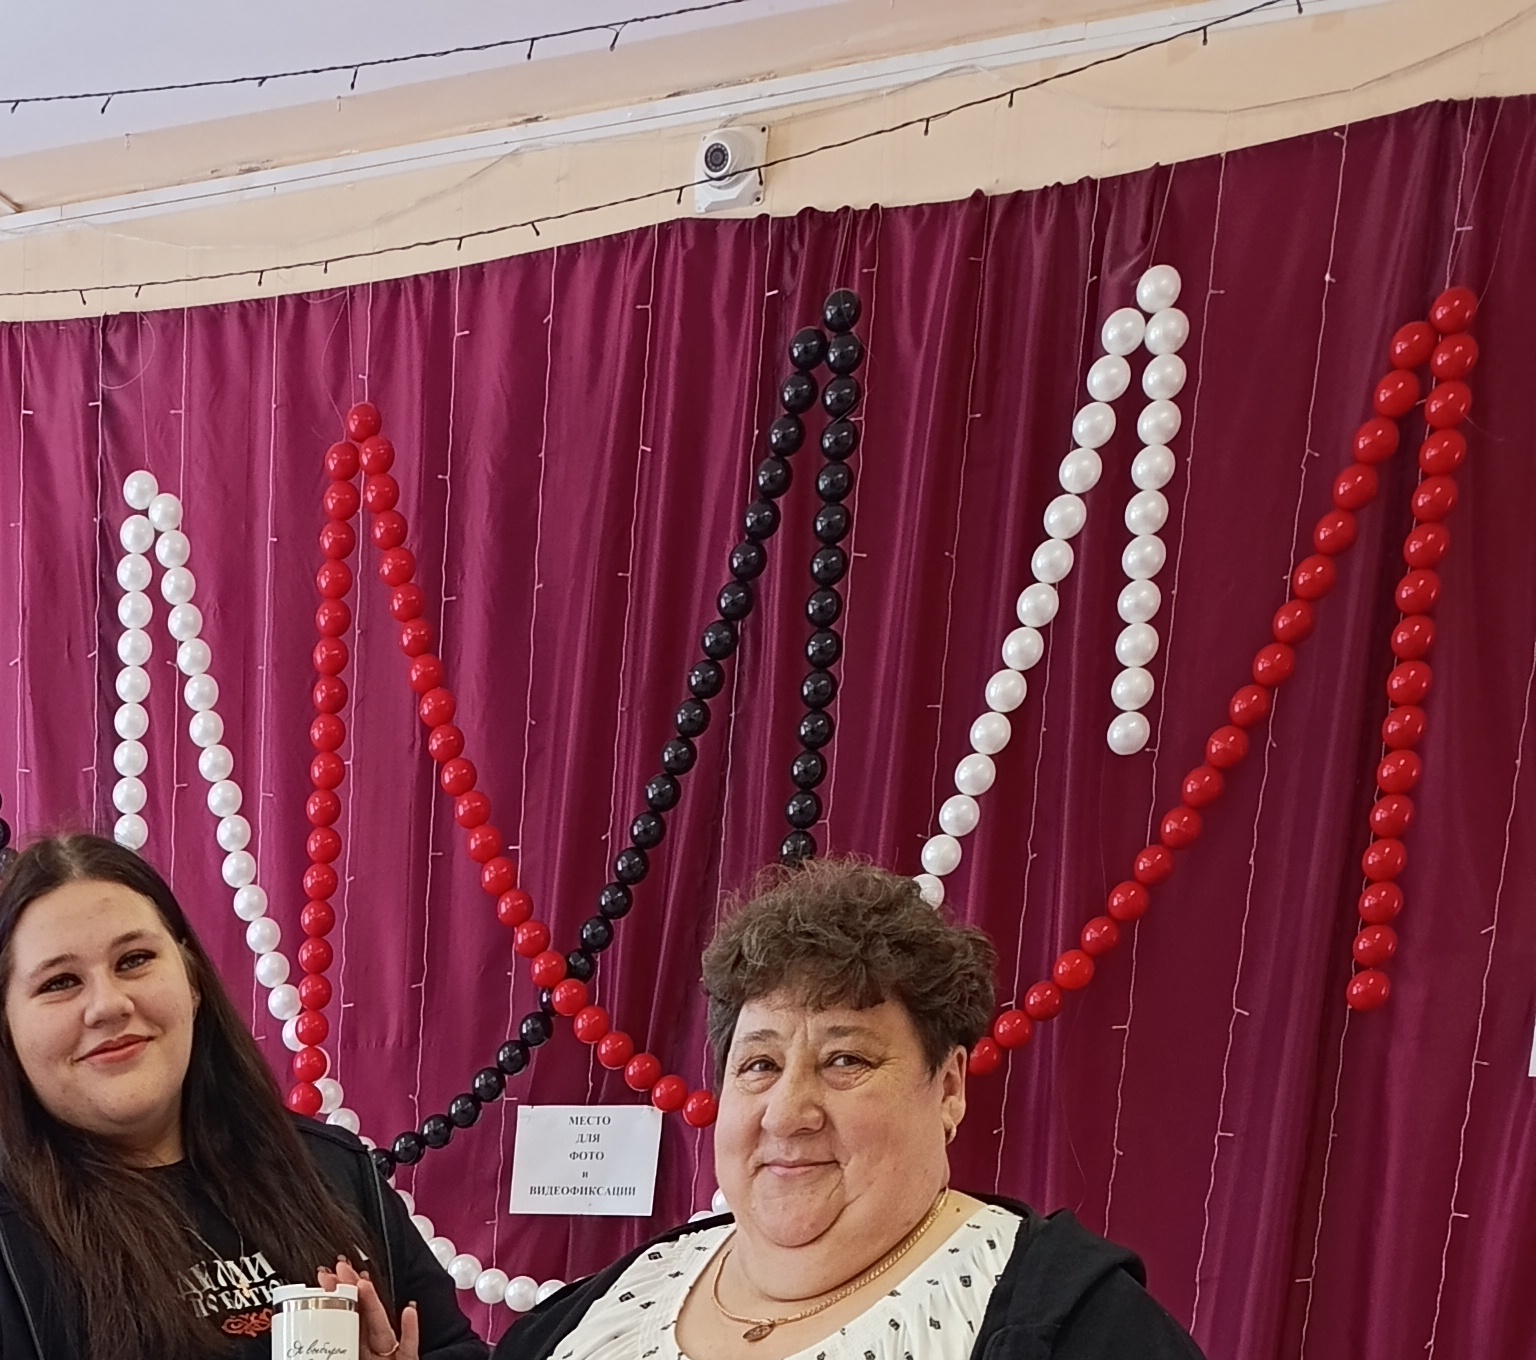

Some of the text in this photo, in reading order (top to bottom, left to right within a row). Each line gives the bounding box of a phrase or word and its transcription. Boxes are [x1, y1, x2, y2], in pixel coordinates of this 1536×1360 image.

[569, 1116, 611, 1125] МЕСТО
[575, 1133, 600, 1143] ДЛЯ
[569, 1151, 604, 1160] ФОТО
[529, 1186, 636, 1197] ВИДЕОФИКСАЦИИ
[286, 1340, 304, 1359] Я
